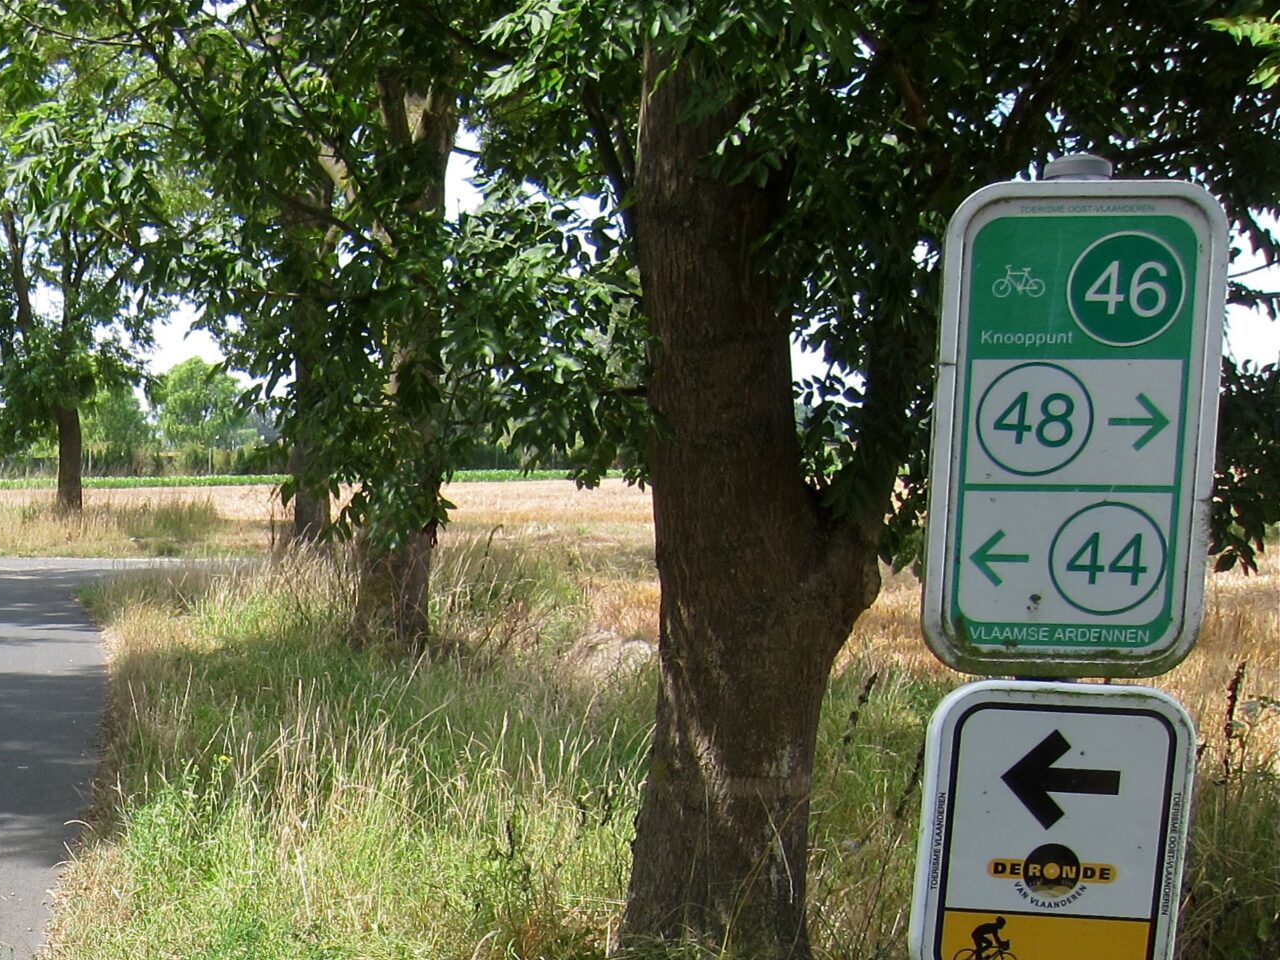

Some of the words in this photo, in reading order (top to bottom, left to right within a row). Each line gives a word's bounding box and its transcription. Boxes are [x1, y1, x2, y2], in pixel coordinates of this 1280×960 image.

[1084, 260, 1168, 318] 46
[980, 329, 1073, 347] Knooppunt
[993, 391, 1075, 448] 48
[1066, 531, 1147, 586] 44
[969, 626, 1050, 641] VLAAMSE
[1053, 628, 1150, 643] ARDENNEN
[935, 792, 946, 847] VLAANDEREN
[930, 848, 942, 891] TOERISME
[992, 861, 1022, 876] DE
[1028, 862, 1112, 881] RONDE
[1014, 881, 1029, 900] VAN
[1030, 884, 1088, 909] VLAANDEREN
